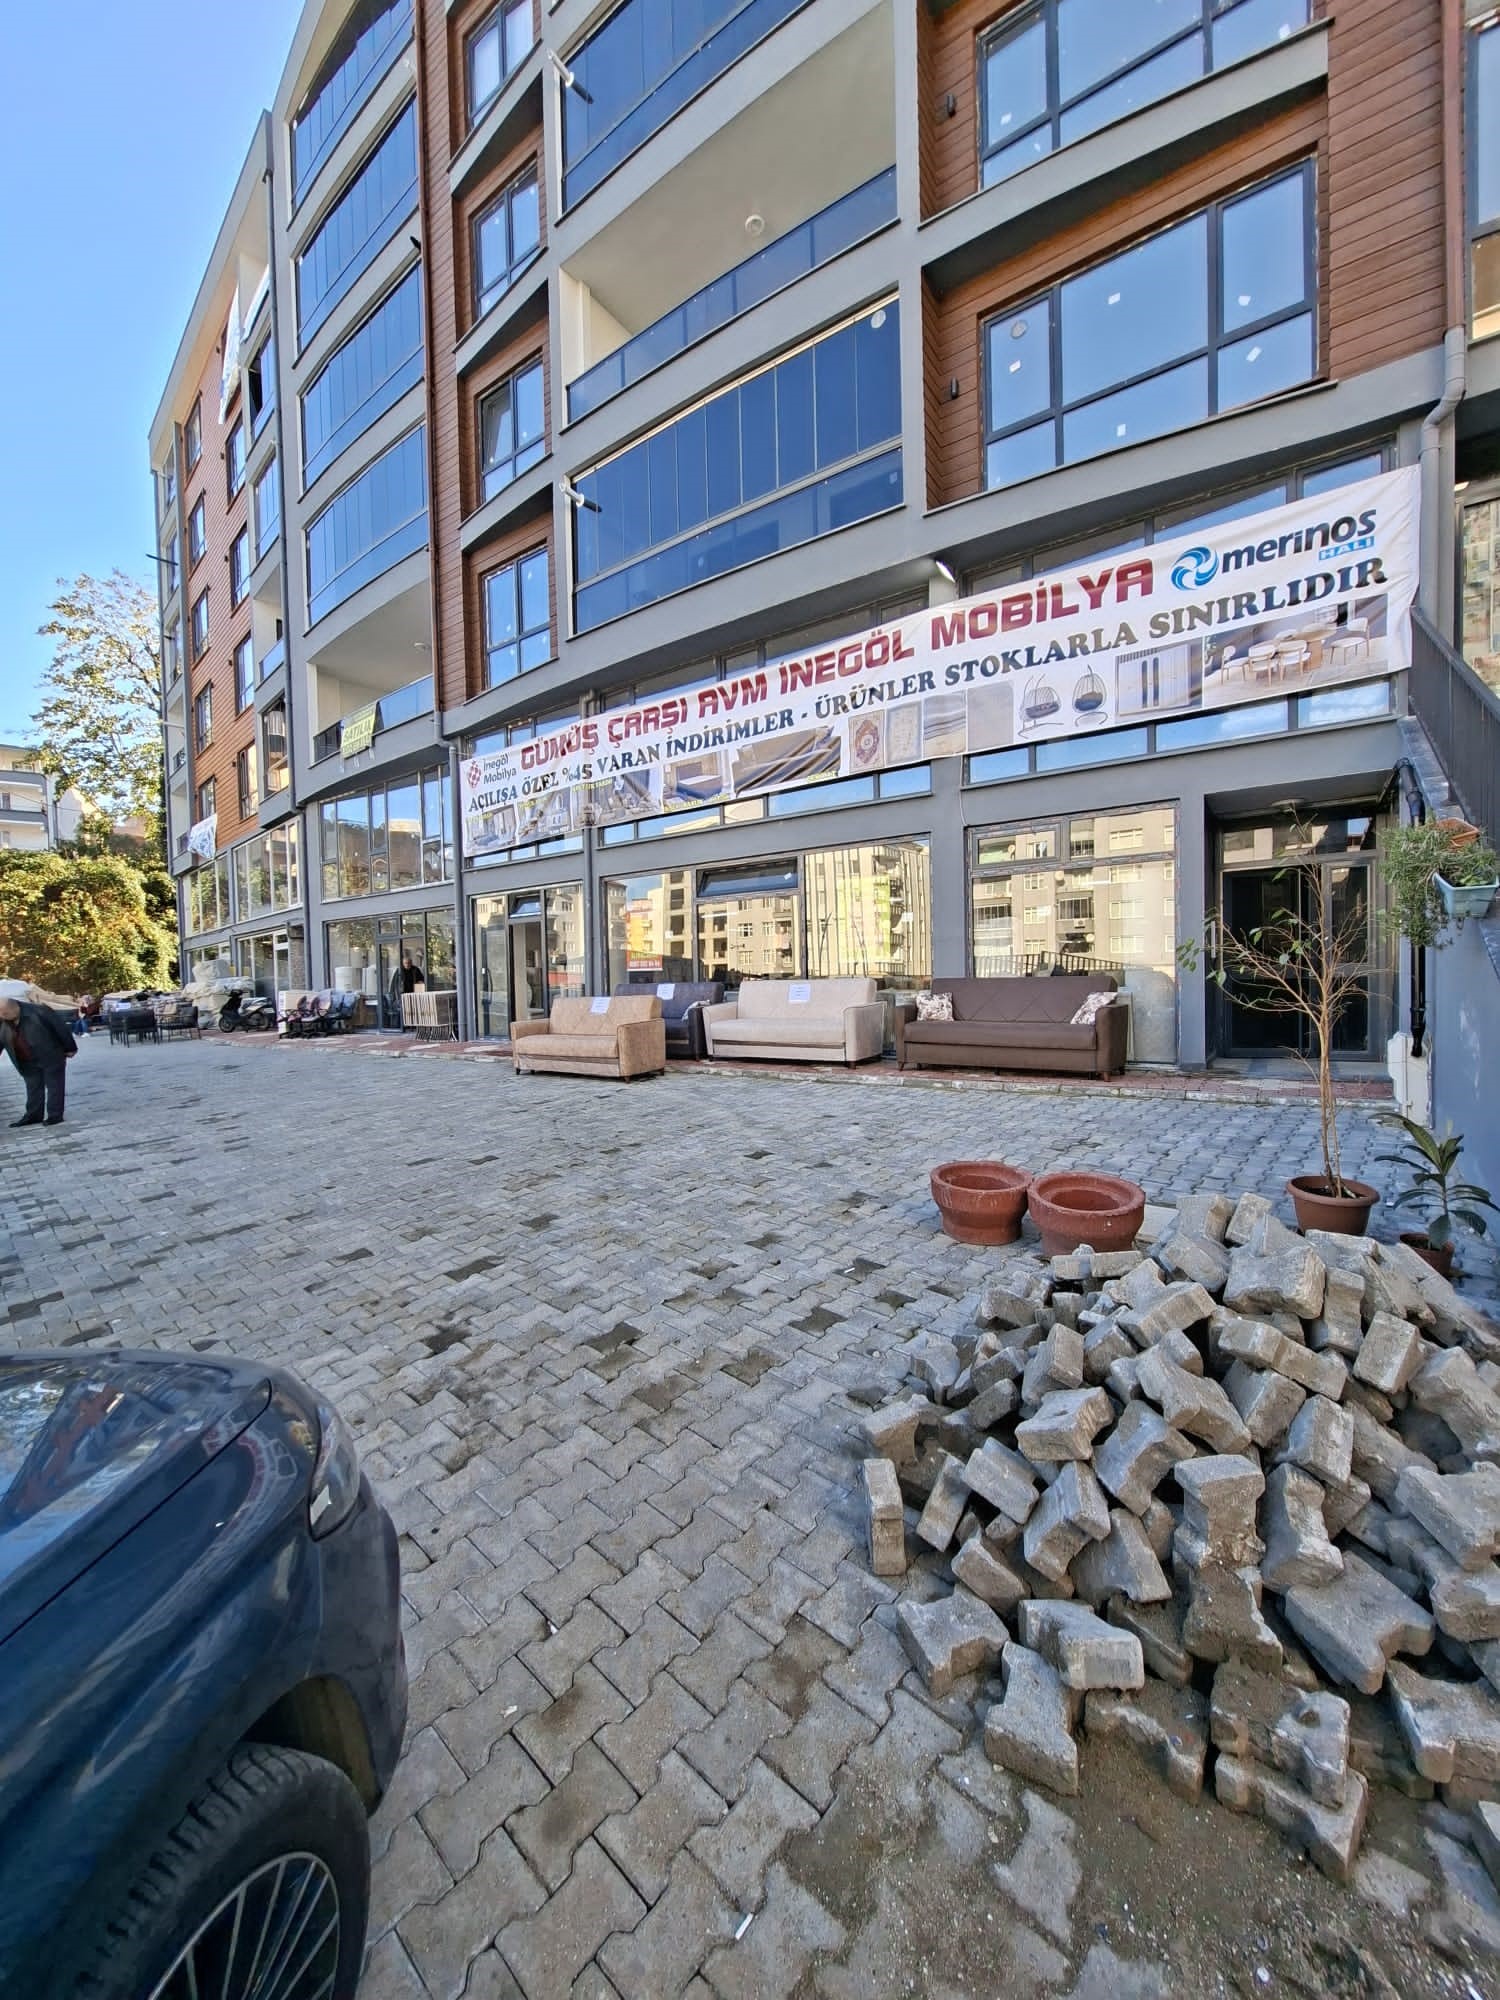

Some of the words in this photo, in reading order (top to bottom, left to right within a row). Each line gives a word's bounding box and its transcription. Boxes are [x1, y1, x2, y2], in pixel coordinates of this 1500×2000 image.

[1222, 509, 1377, 573] merinos
[1320, 537, 1374, 560] HALI
[468, 785, 518, 812] AÇILIŞA
[522, 772, 559, 795] ÖZEL
[597, 743, 660, 774] VARAN
[666, 708, 794, 758] İNDİRİMLER
[815, 670, 936, 719] ÜRÜNLER
[945, 622, 1138, 687] STOKLARLA
[1149, 557, 1388, 639] SINIRLIDIR
[521, 723, 600, 770] GÜMÜŞ
[607, 698, 688, 748] ÇARŞI
[698, 672, 768, 718] AVM
[778, 629, 915, 695] İNEGÖL
[931, 558, 1153, 650] MOBİLYA
[483, 752, 509, 771] İnegöl
[483, 767, 517, 784] Mobilya
